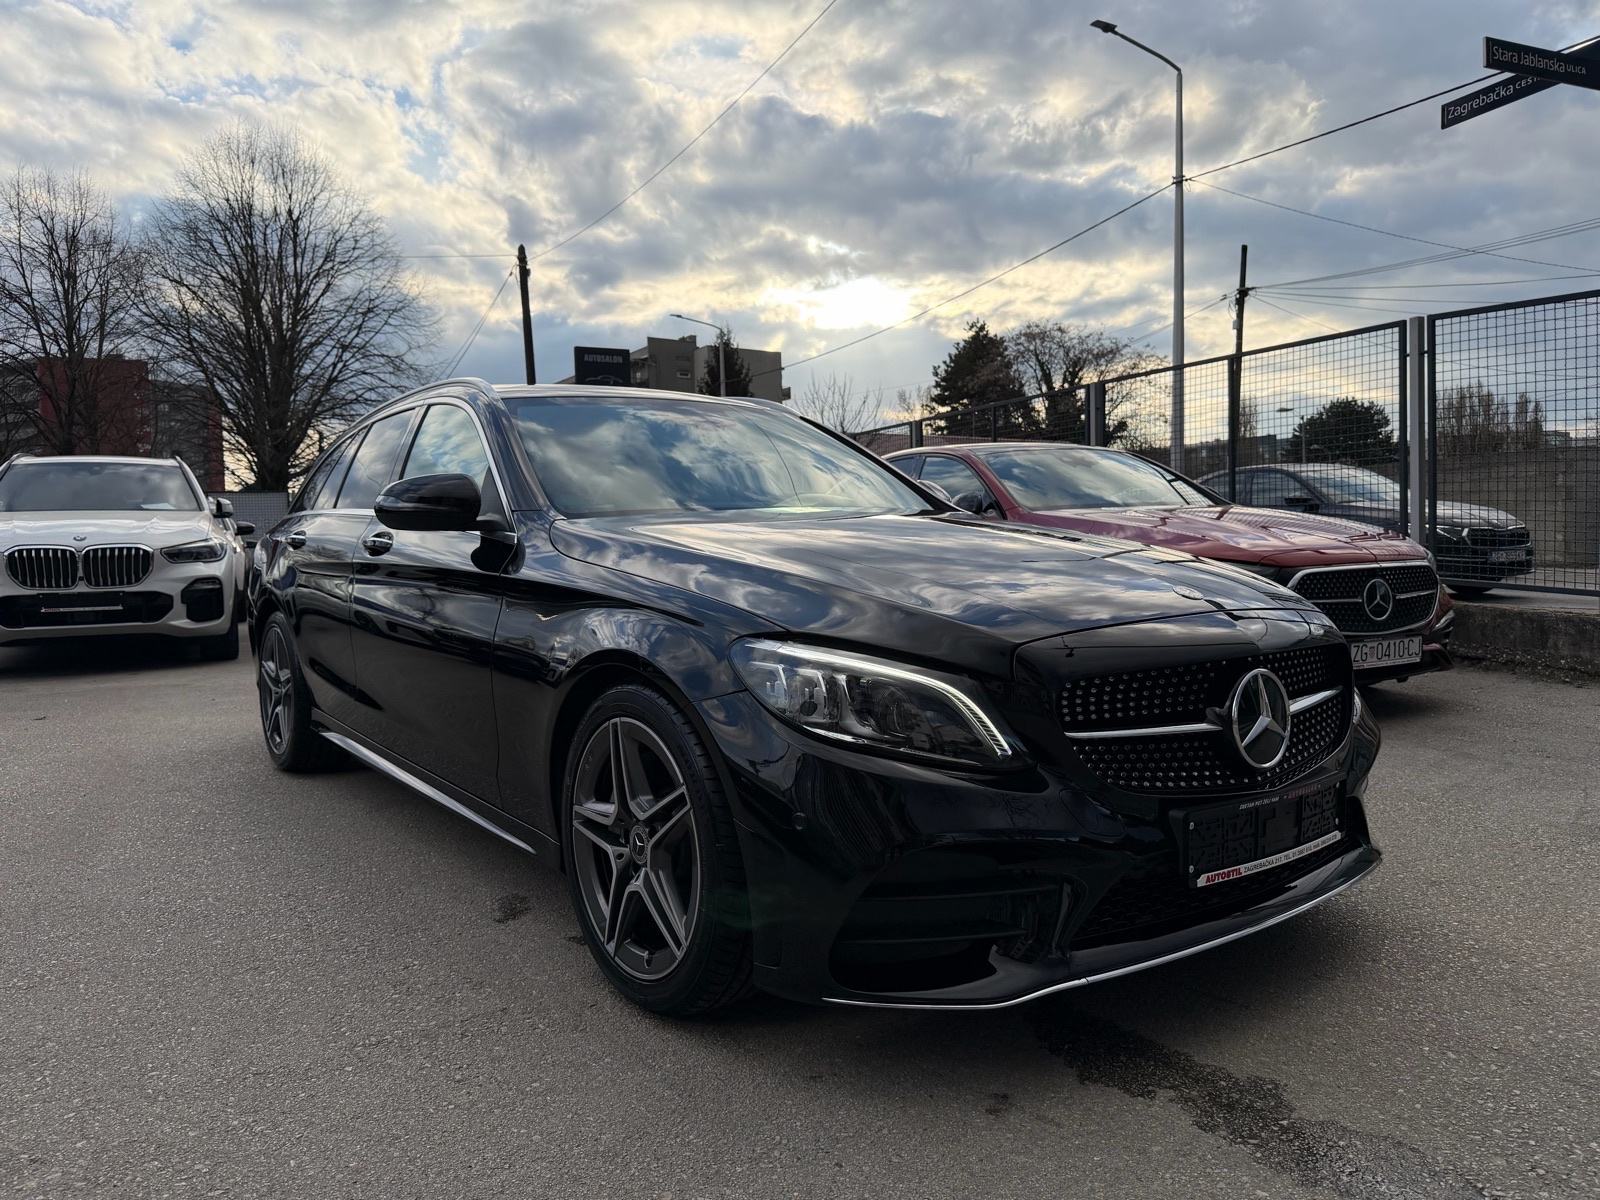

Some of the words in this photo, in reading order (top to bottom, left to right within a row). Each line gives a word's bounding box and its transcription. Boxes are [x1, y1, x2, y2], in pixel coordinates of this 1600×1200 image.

[1493, 46, 1518, 63] Stara
[1520, 53, 1565, 73] Jablanska
[1566, 64, 1586, 75] ULICA
[1448, 85, 1514, 119] Zagrebačka
[1516, 76, 1539, 89] CES
[584, 354, 623, 363] AUTOSALON
[1353, 644, 1368, 662] ZG
[1376, 638, 1421, 660] 0410-CJ
[1205, 867, 1243, 884] AUTOSTIL
[1244, 858, 1275, 873] ZAGREBAČKA
